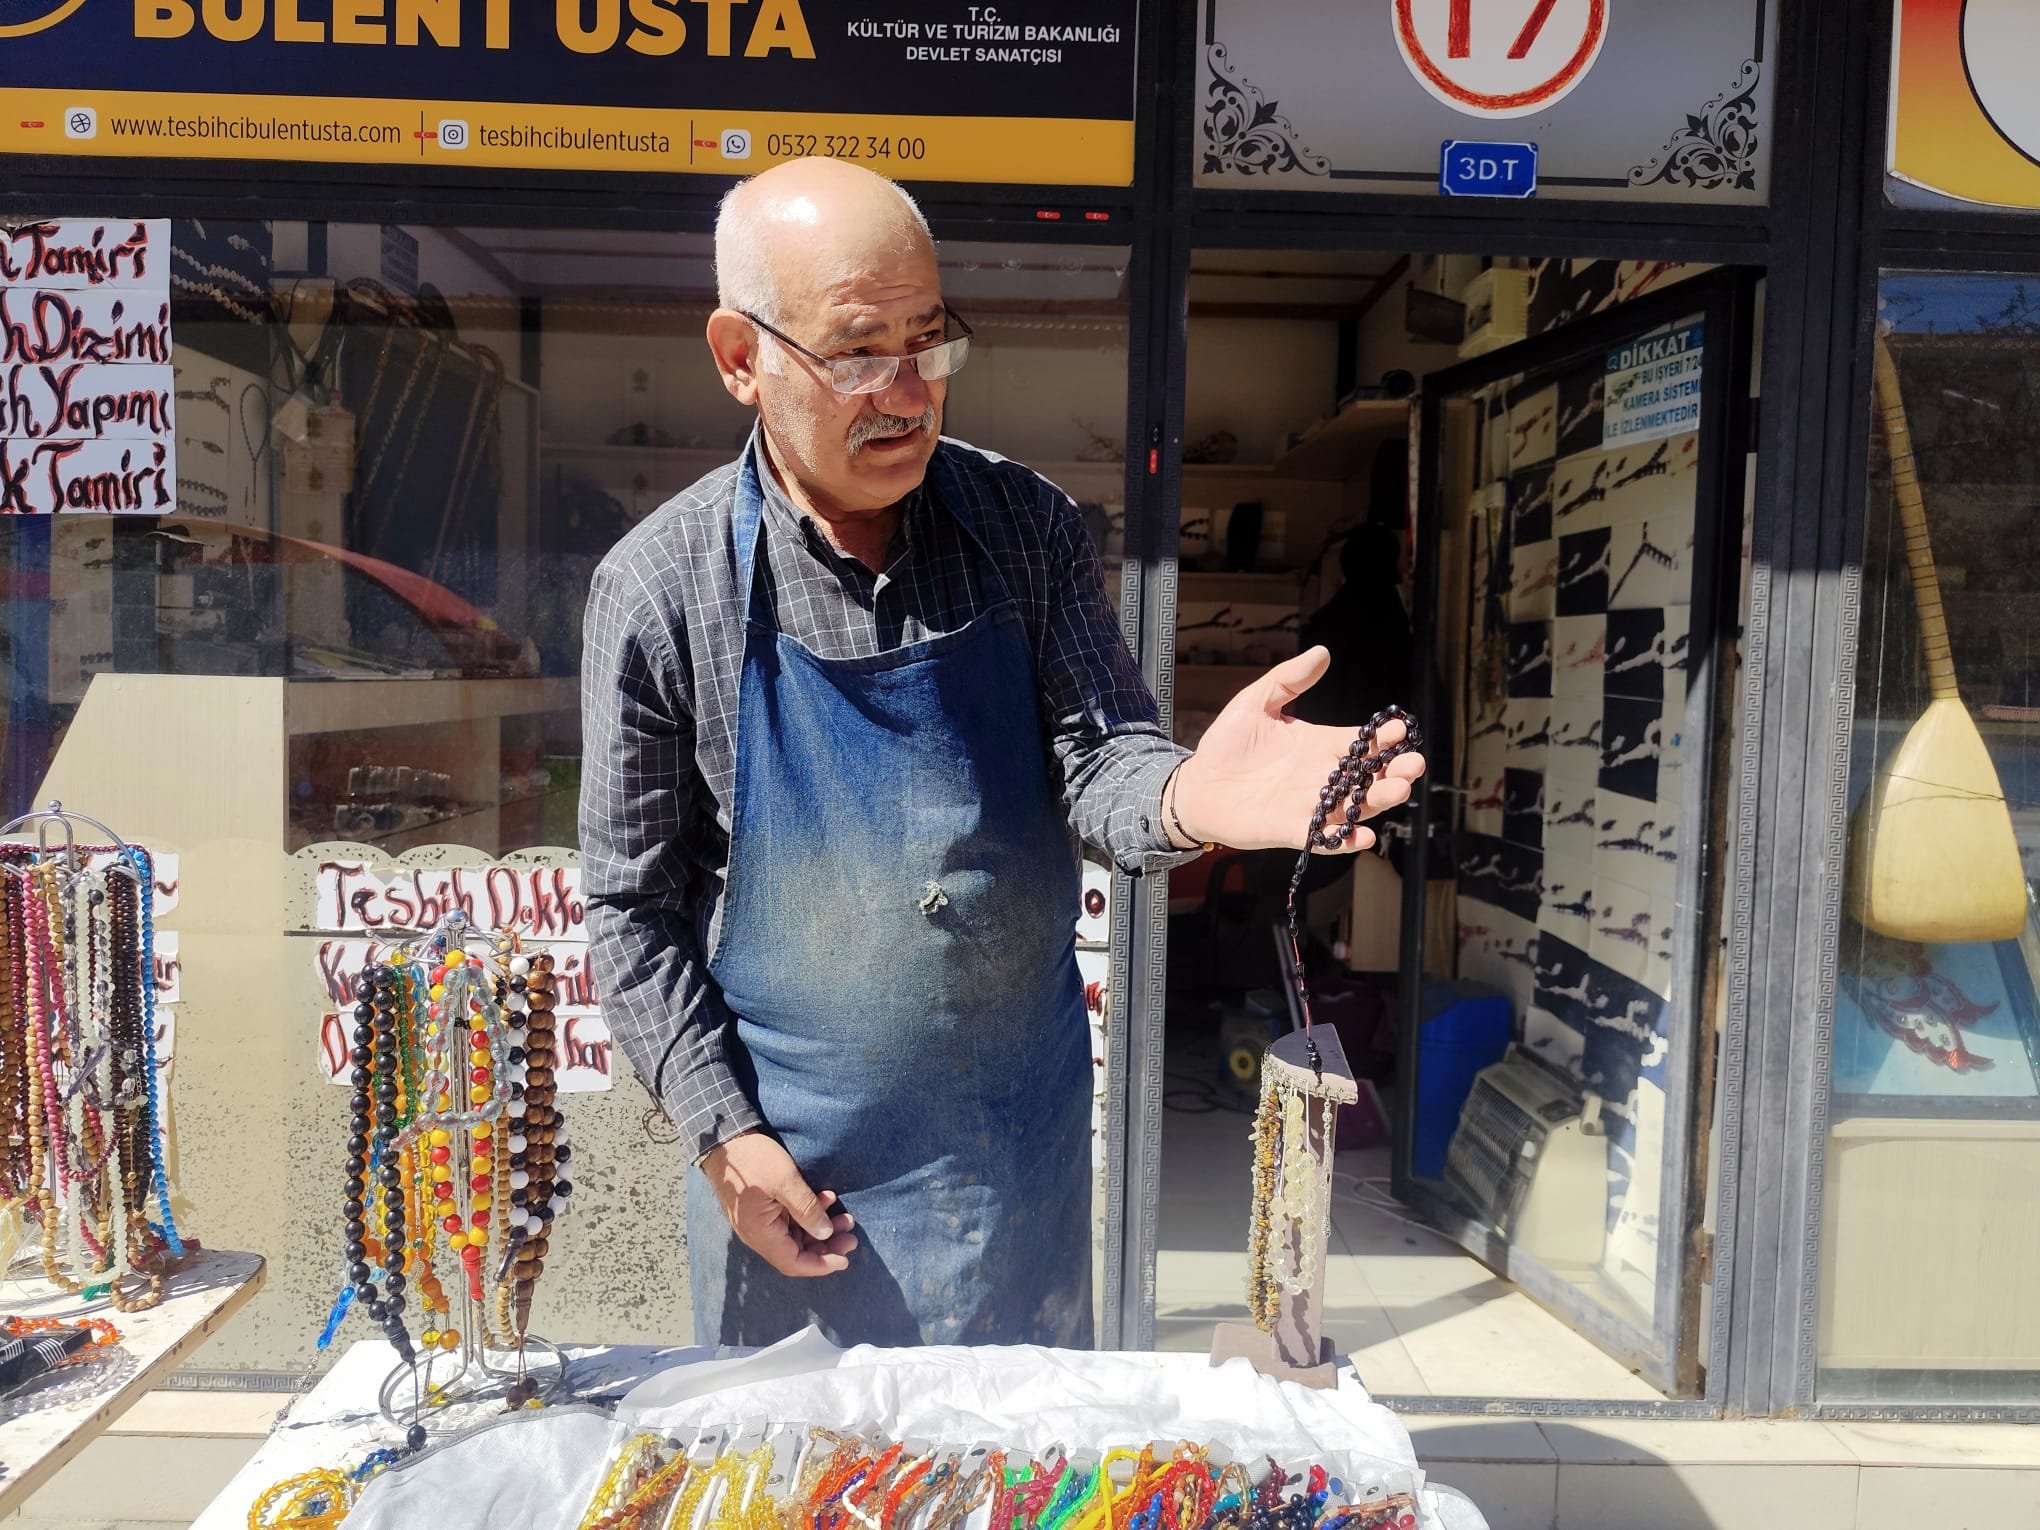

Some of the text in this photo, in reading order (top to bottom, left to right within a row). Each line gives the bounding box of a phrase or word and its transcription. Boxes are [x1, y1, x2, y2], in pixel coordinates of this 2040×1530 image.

[967, 6, 1002, 24] T.Ç.
[555, 0, 818, 60] USTA
[847, 18, 1121, 44] KÜLTÜR VE TURİZM BAKANLIĞI
[905, 45, 1063, 66] DEVLET SANATÇISI
[110, 114, 402, 145] www.tesbihcibulentusta.com
[479, 124, 670, 153] tesbihcibulentusta
[767, 133, 926, 160] 0532 322 34 00
[1620, 330, 1691, 369] DİKKAT
[1641, 367, 1654, 385] BU
[1623, 388, 1660, 411] KAMERA
[1620, 400, 1698, 434] İZLENMEKTEDİR
[32, 440, 170, 514] Tamiri
